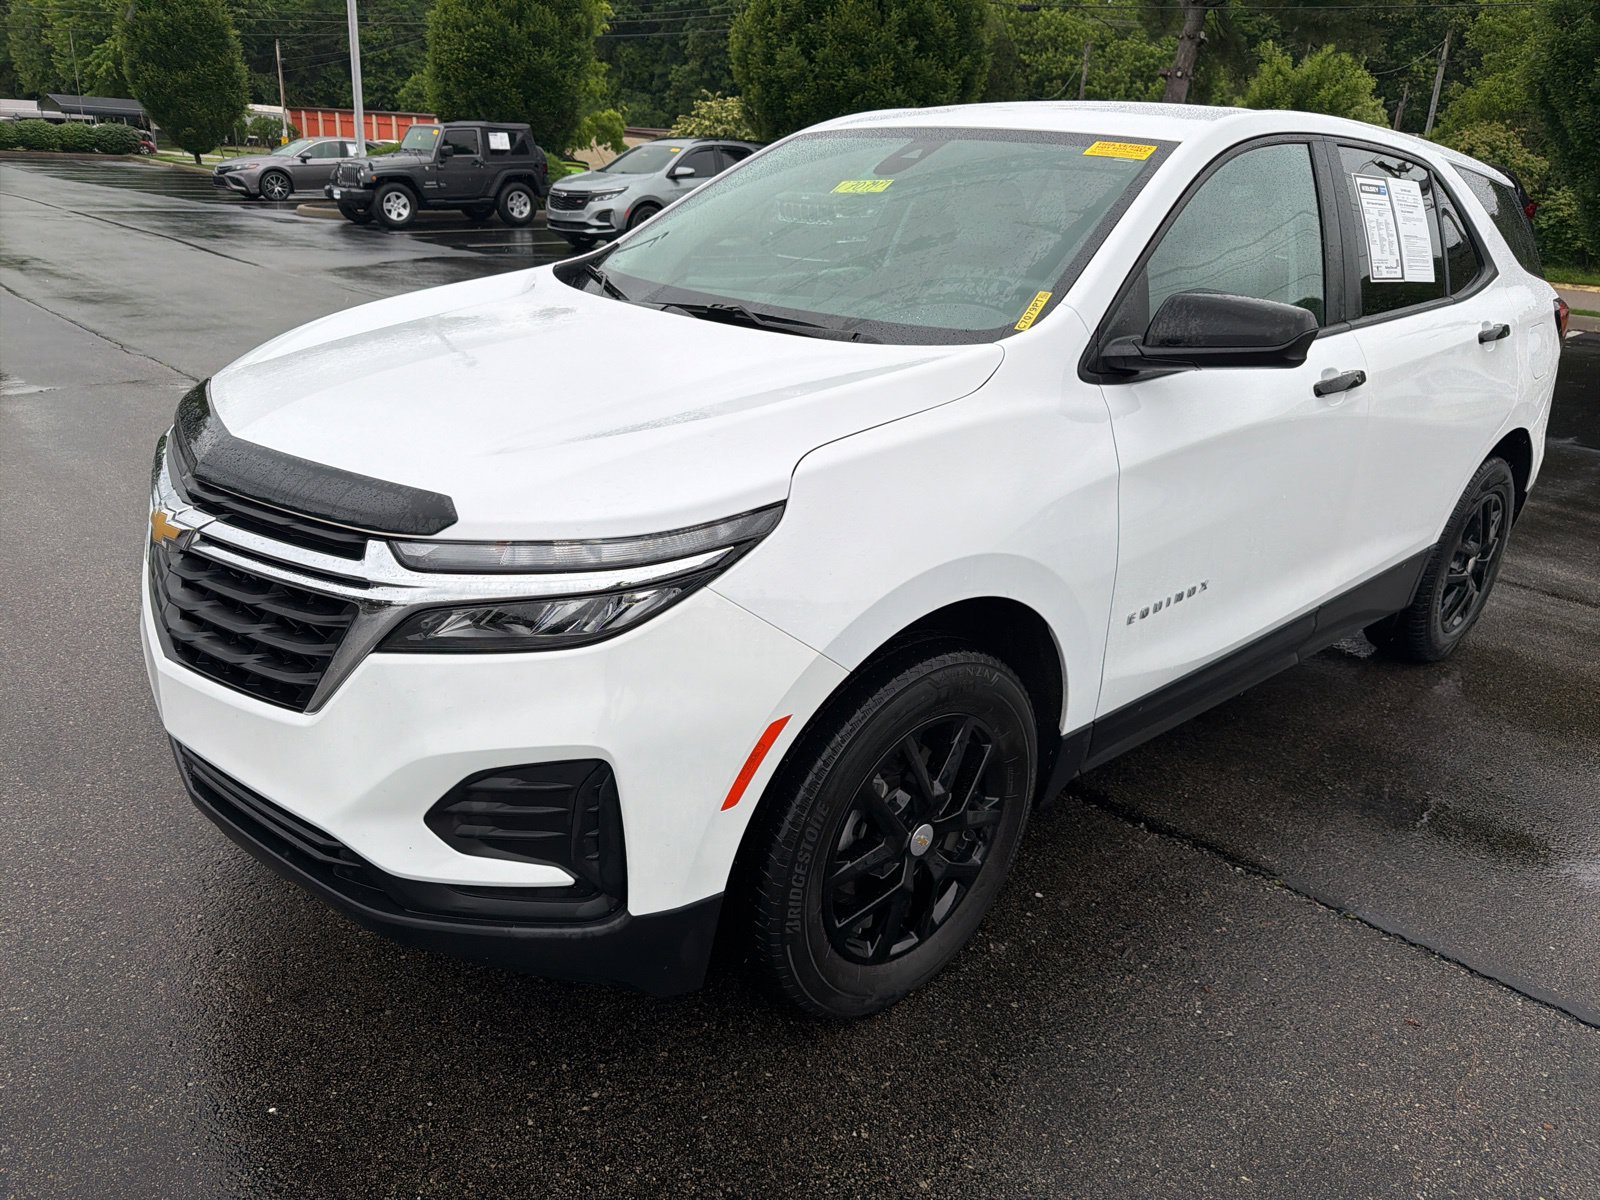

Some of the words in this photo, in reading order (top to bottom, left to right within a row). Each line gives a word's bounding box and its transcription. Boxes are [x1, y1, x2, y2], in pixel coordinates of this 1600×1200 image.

[1017, 297, 1044, 329] C7079PT
[1126, 580, 1209, 626] EQUINOX
[785, 801, 830, 934] BRIDGESTONE
